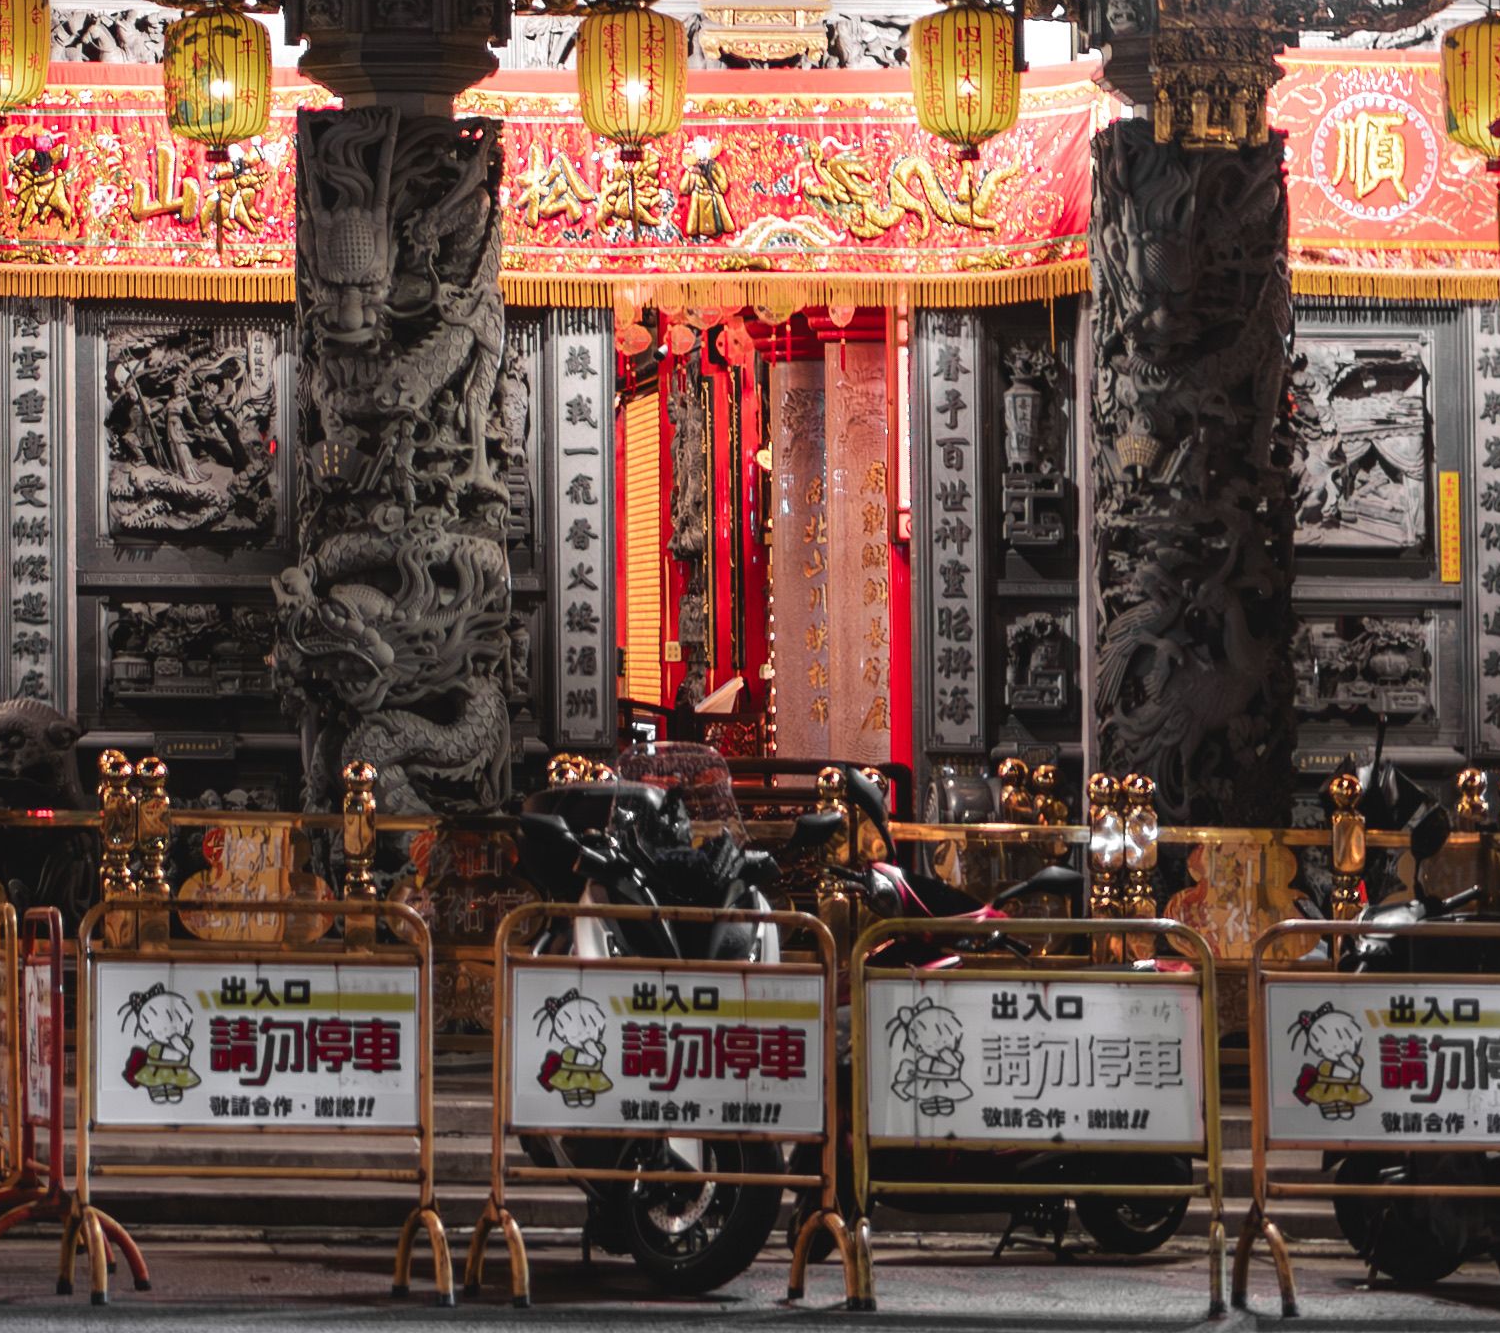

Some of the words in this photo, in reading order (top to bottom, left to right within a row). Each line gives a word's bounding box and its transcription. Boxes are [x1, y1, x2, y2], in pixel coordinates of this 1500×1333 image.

[1333, 108, 1409, 204] 順
[220, 976, 311, 1007] 出入口
[631, 982, 719, 1013] 出入口
[991, 991, 1084, 1022] 出入口
[1389, 995, 1480, 1025] 出入口
[209, 1016, 402, 1086] 請勿停車
[621, 1021, 807, 1091] 請勿停車
[981, 1034, 1184, 1100] 請勿停車
